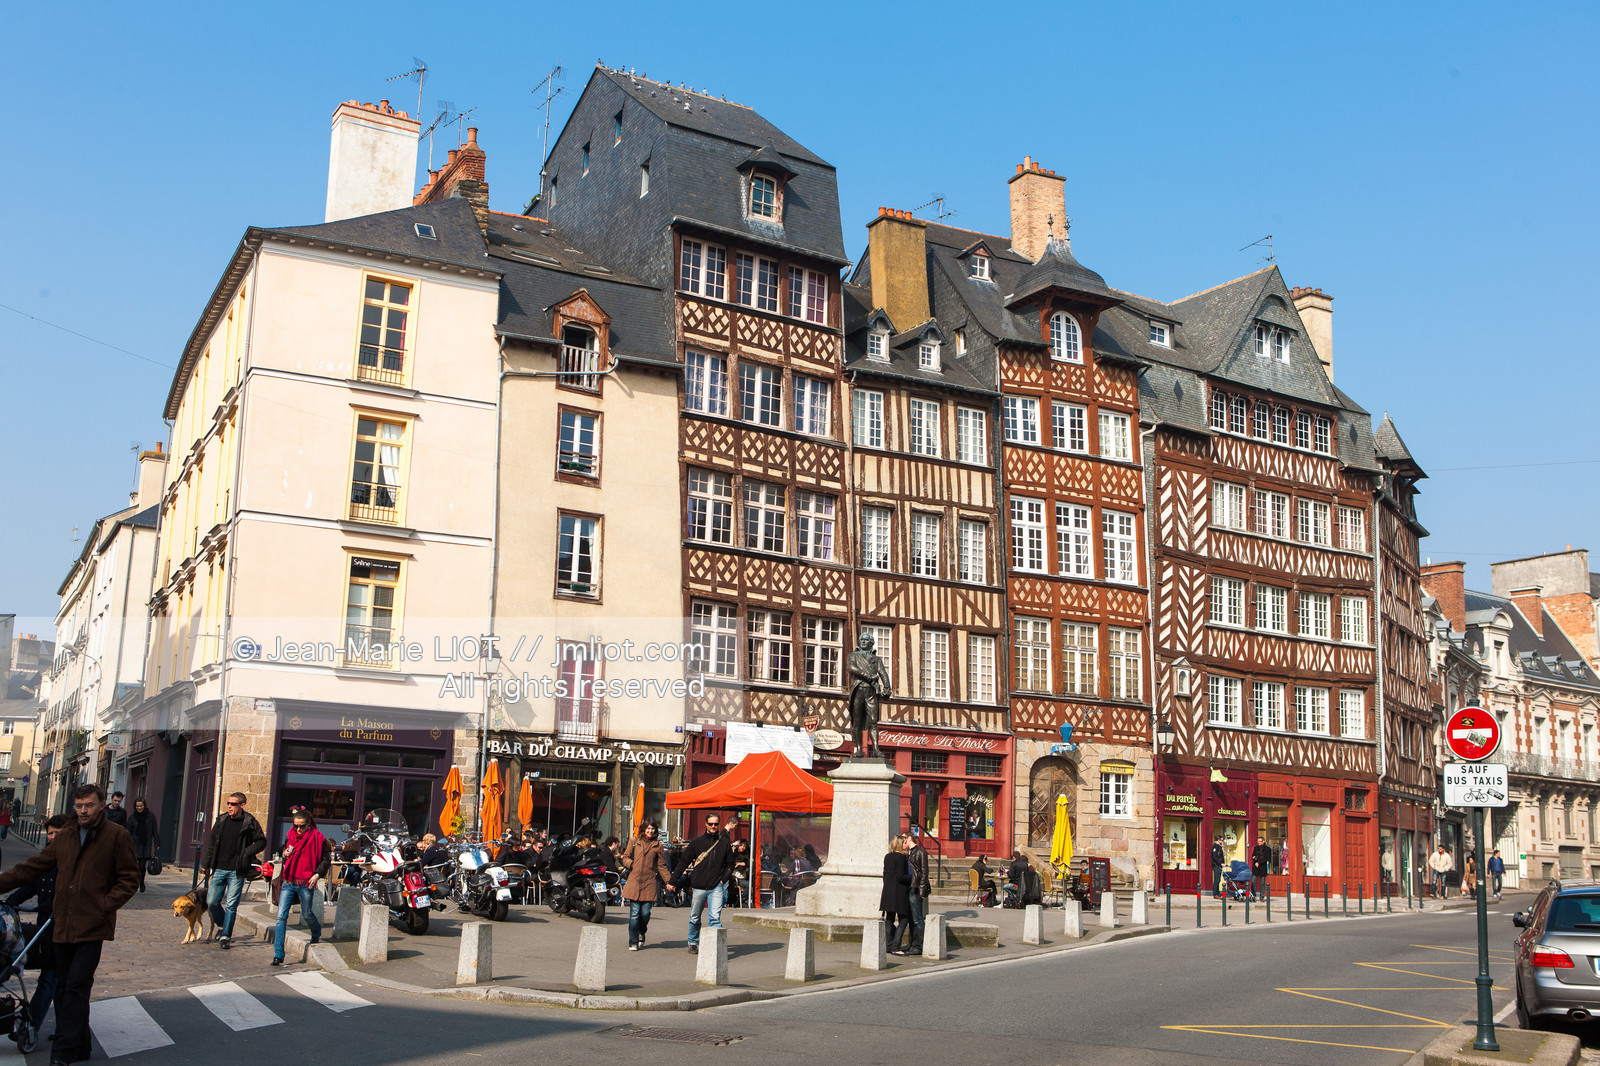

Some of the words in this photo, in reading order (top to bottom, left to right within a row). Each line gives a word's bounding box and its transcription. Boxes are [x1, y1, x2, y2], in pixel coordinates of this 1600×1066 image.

[340, 717, 354, 728] La
[357, 718, 394, 730] Maison
[340, 728, 352, 739] du
[356, 730, 393, 741] Parfum
[878, 730, 930, 746] Crêperie
[932, 734, 954, 746] La
[490, 740, 523, 756] BAR
[528, 743, 549, 757] DU
[555, 746, 612, 761] CHAMP
[618, 750, 684, 766] JACQUET
[1461, 766, 1488, 774] SAUF
[1447, 776, 1467, 784] BUS
[1473, 776, 1503, 785] TAXIS
[1218, 807, 1246, 816] chaussures
